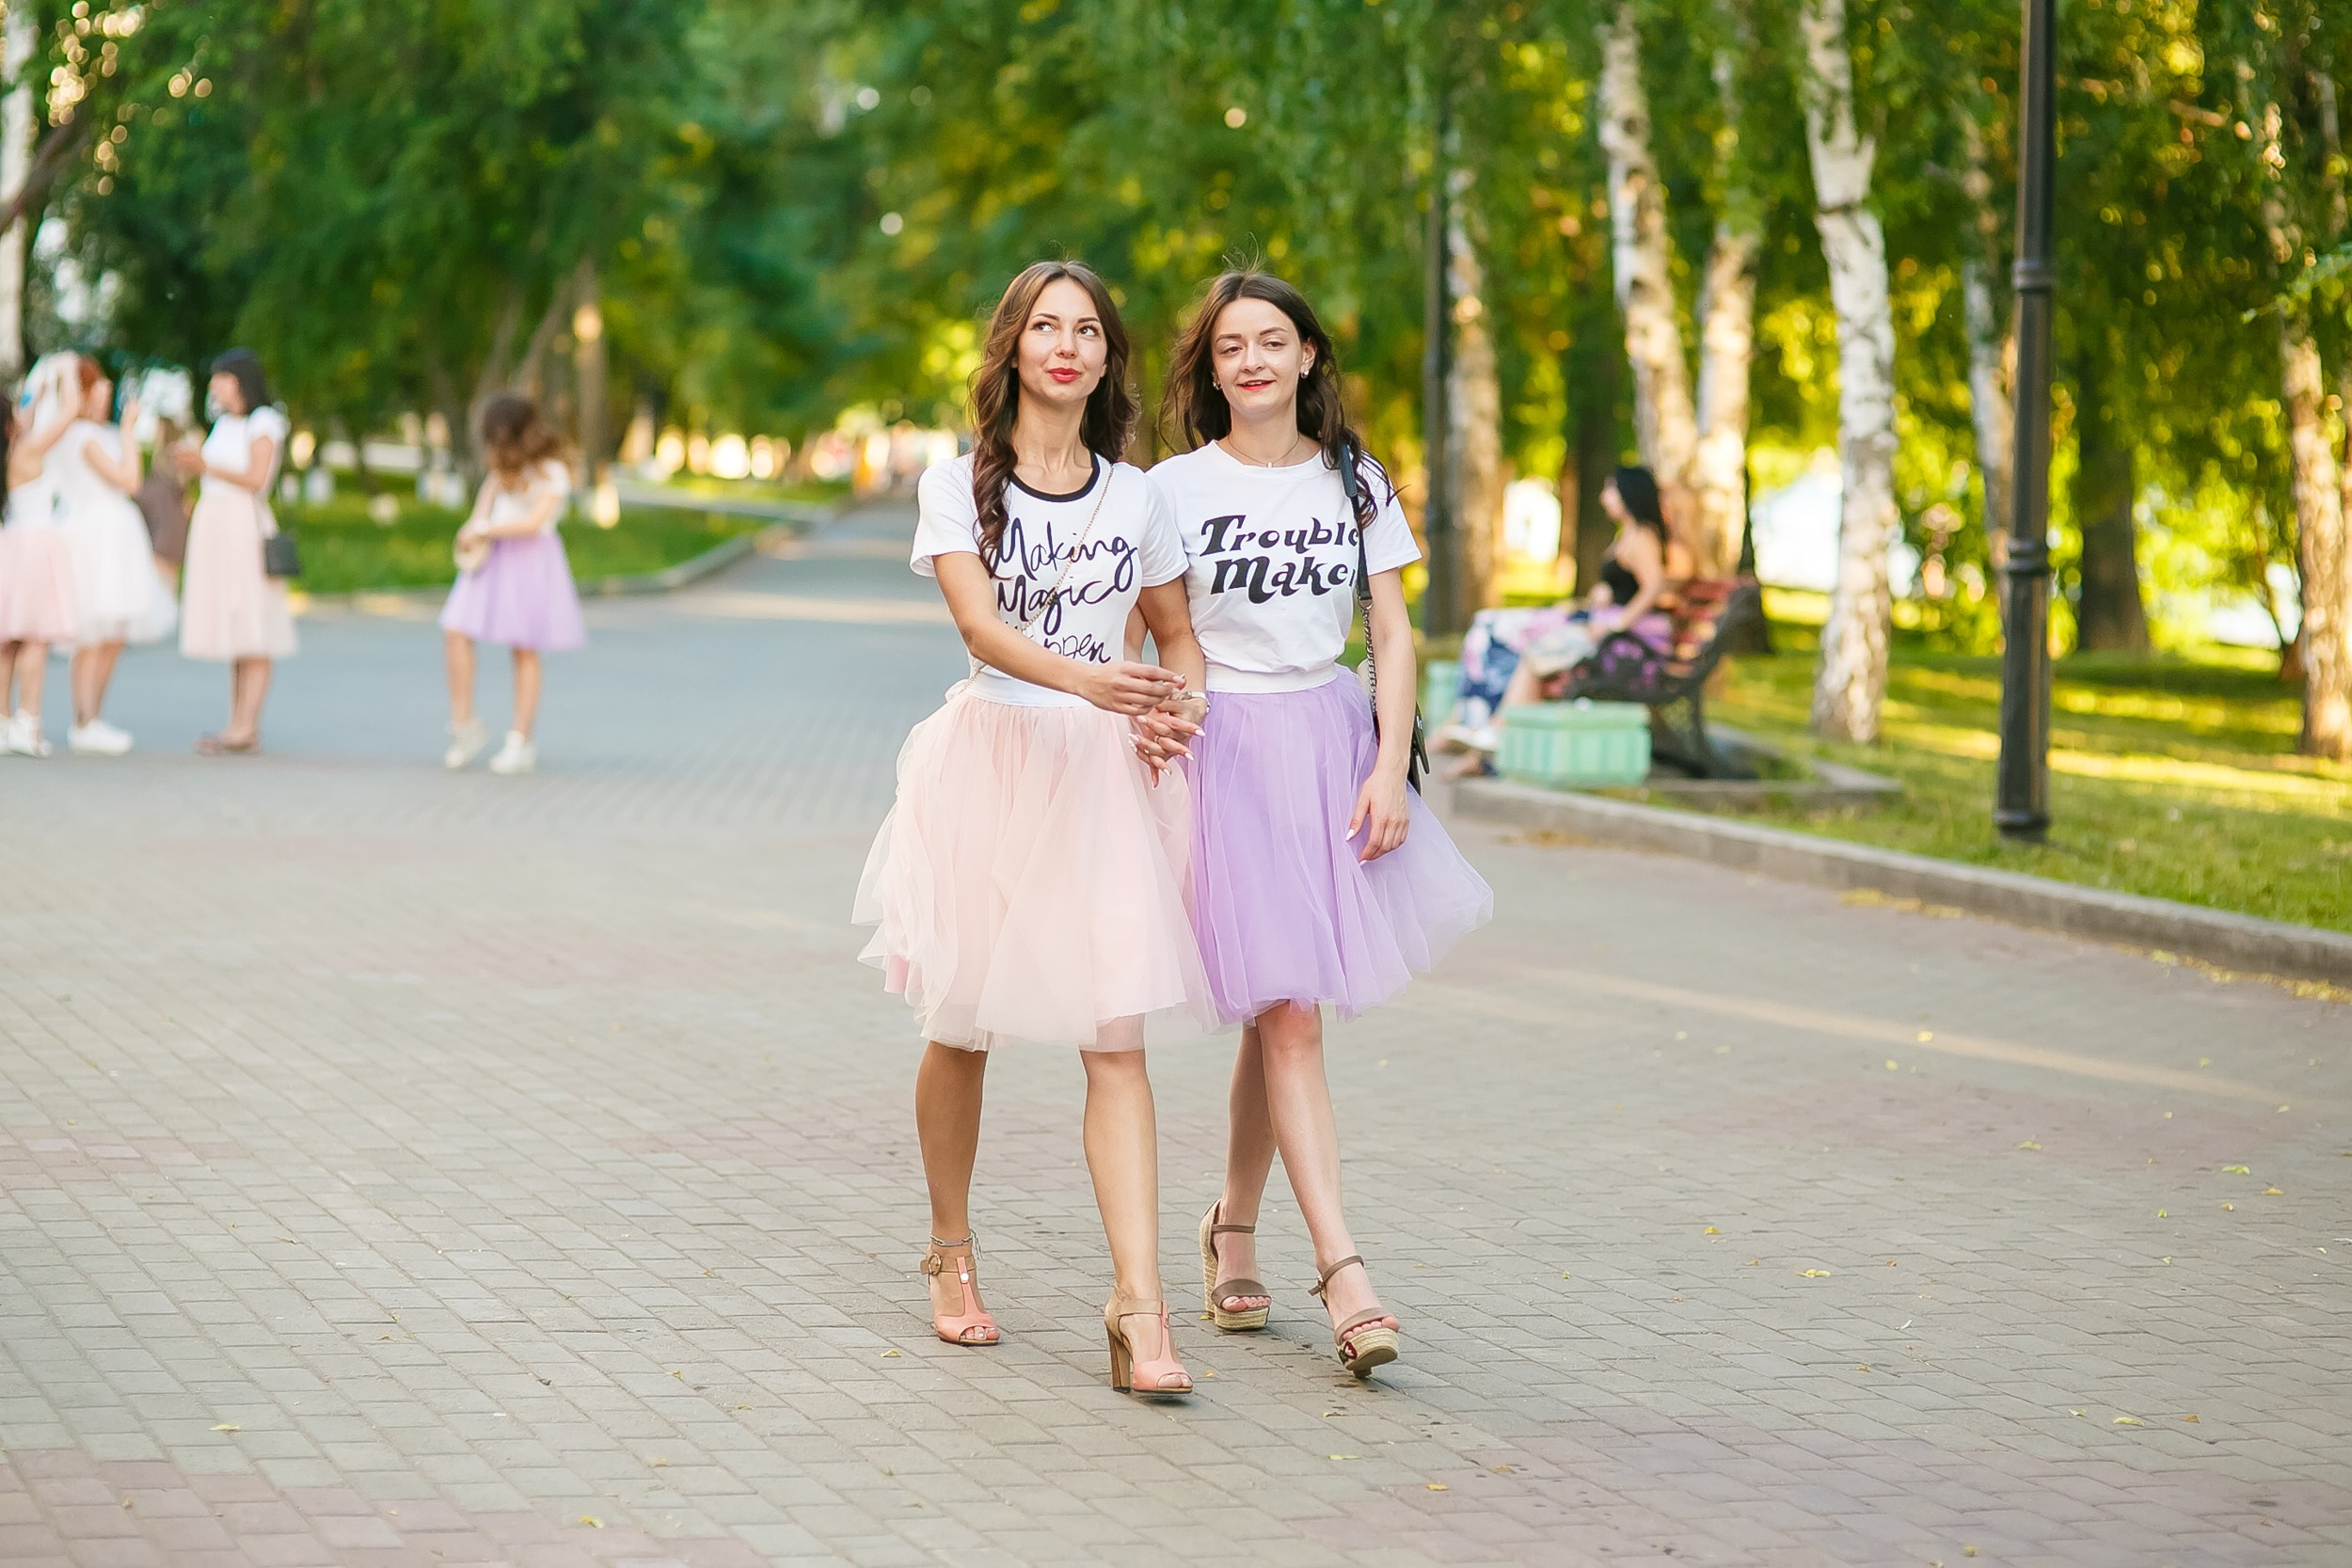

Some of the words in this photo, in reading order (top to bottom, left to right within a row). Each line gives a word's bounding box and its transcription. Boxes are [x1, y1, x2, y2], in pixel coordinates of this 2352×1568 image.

[992, 517, 1137, 593] Making
[1200, 515, 1359, 557] Trouble
[997, 575, 1117, 636] Magic
[1211, 556, 1356, 604] Make
